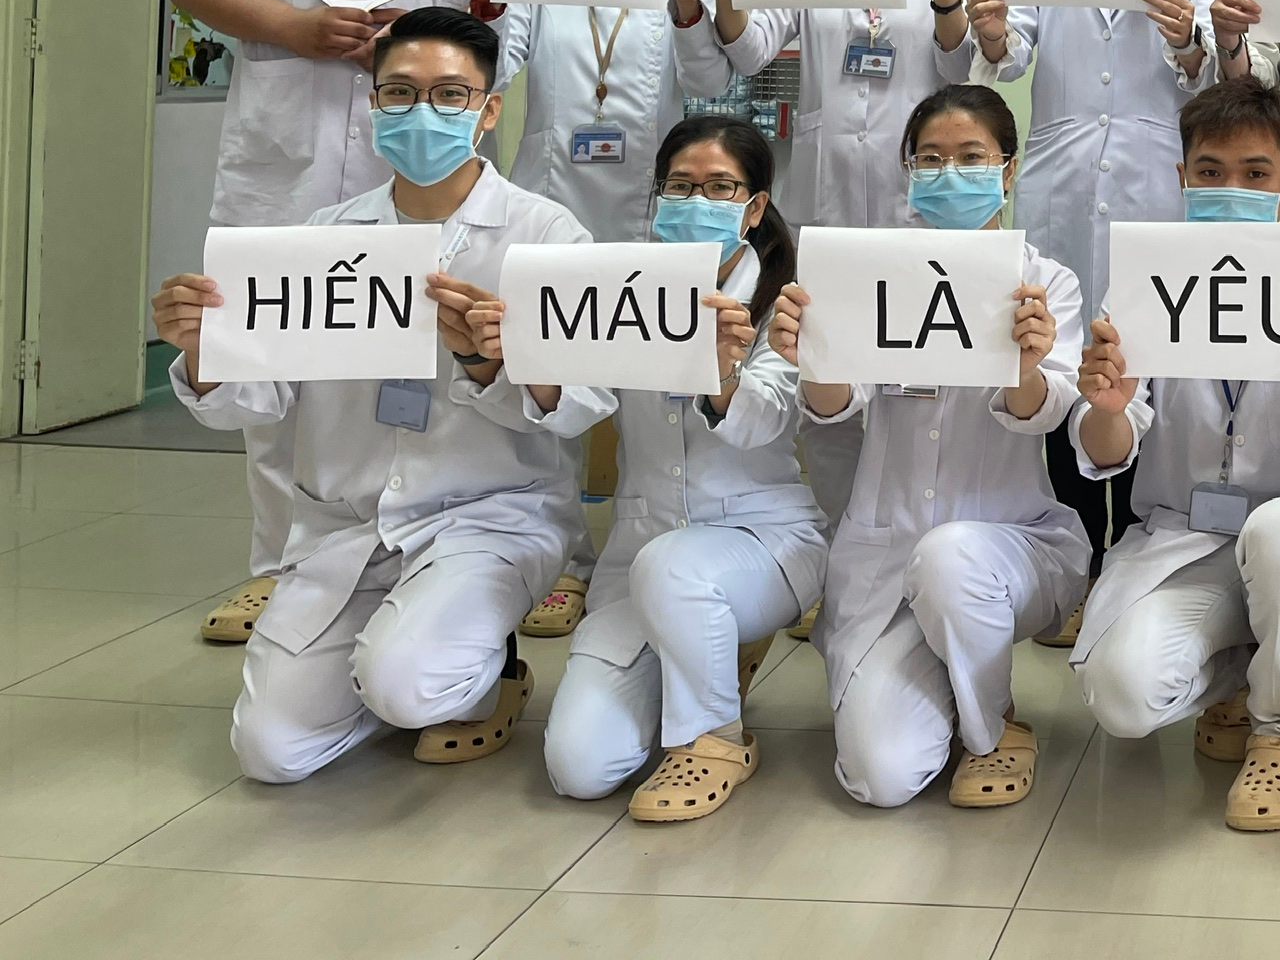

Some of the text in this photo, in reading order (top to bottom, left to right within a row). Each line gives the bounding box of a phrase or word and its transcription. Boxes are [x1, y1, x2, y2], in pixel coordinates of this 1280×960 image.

[246, 253, 412, 330] HIẾN
[540, 271, 699, 342] MÁU
[876, 260, 973, 350] LÀ
